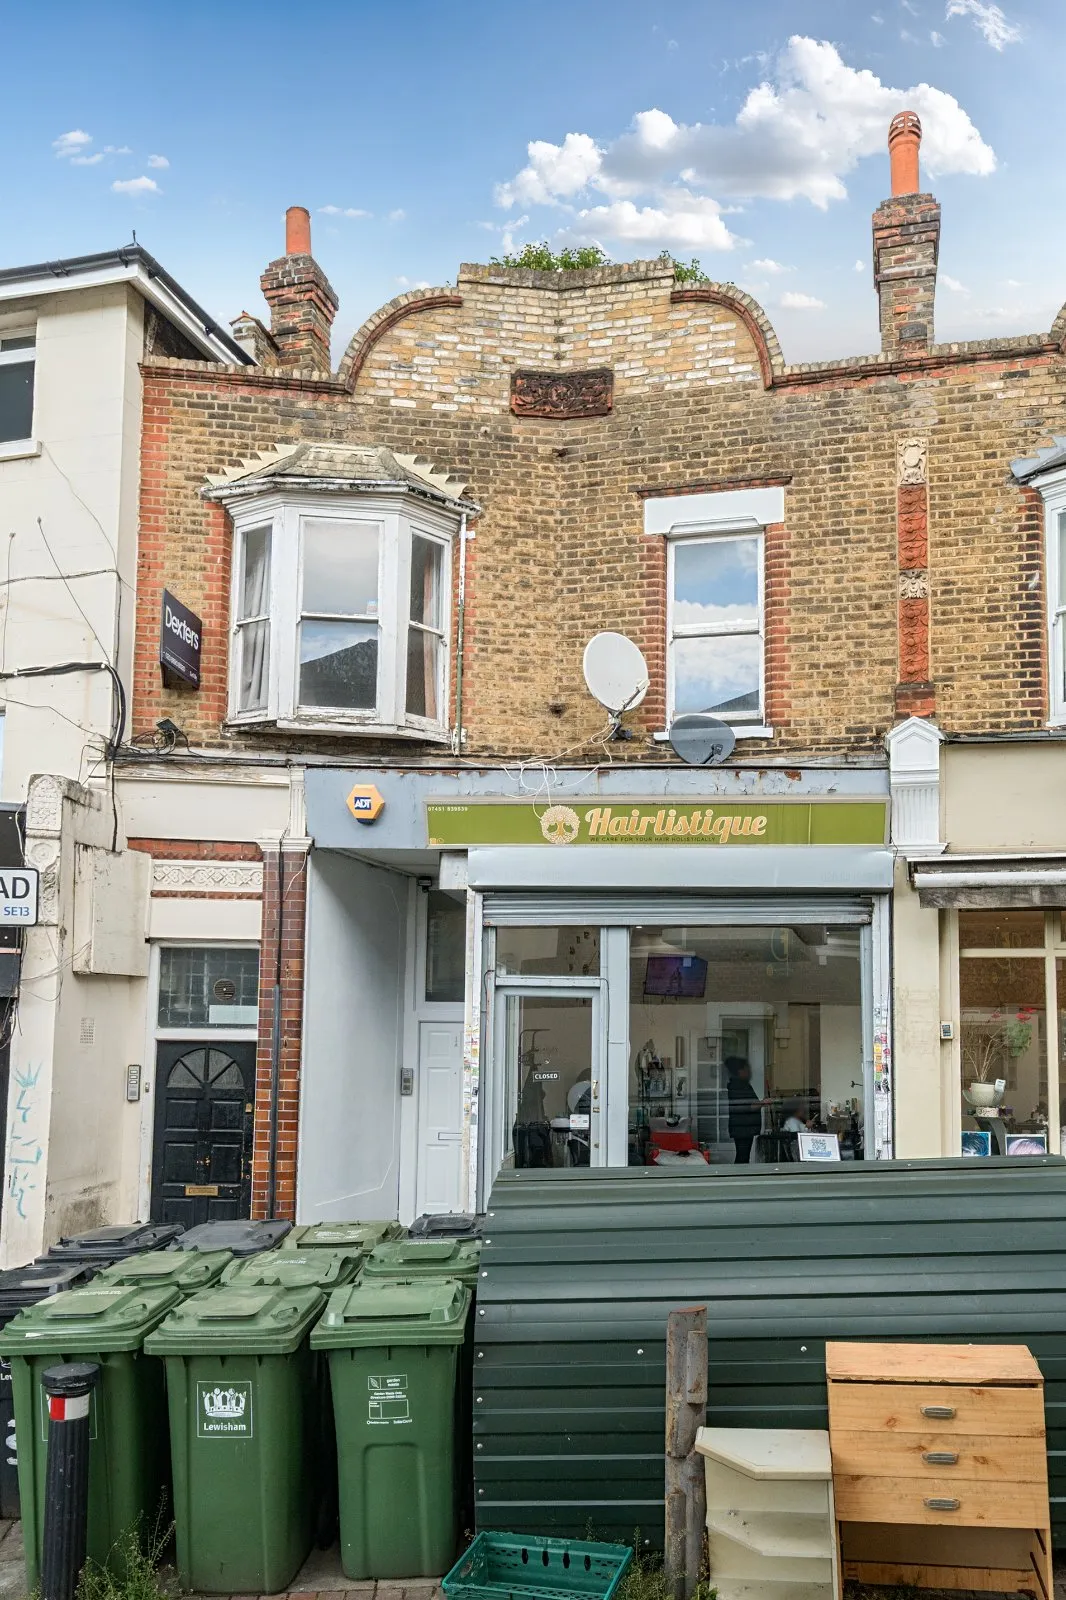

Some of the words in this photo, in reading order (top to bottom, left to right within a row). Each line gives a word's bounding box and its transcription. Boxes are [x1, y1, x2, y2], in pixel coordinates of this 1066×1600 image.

[165, 605, 199, 650] Dexters
[354, 798, 372, 809] ADT
[584, 807, 768, 844] Hairlistique
[3, 906, 30, 917] SE13
[203, 1422, 247, 1431] Lewisham
